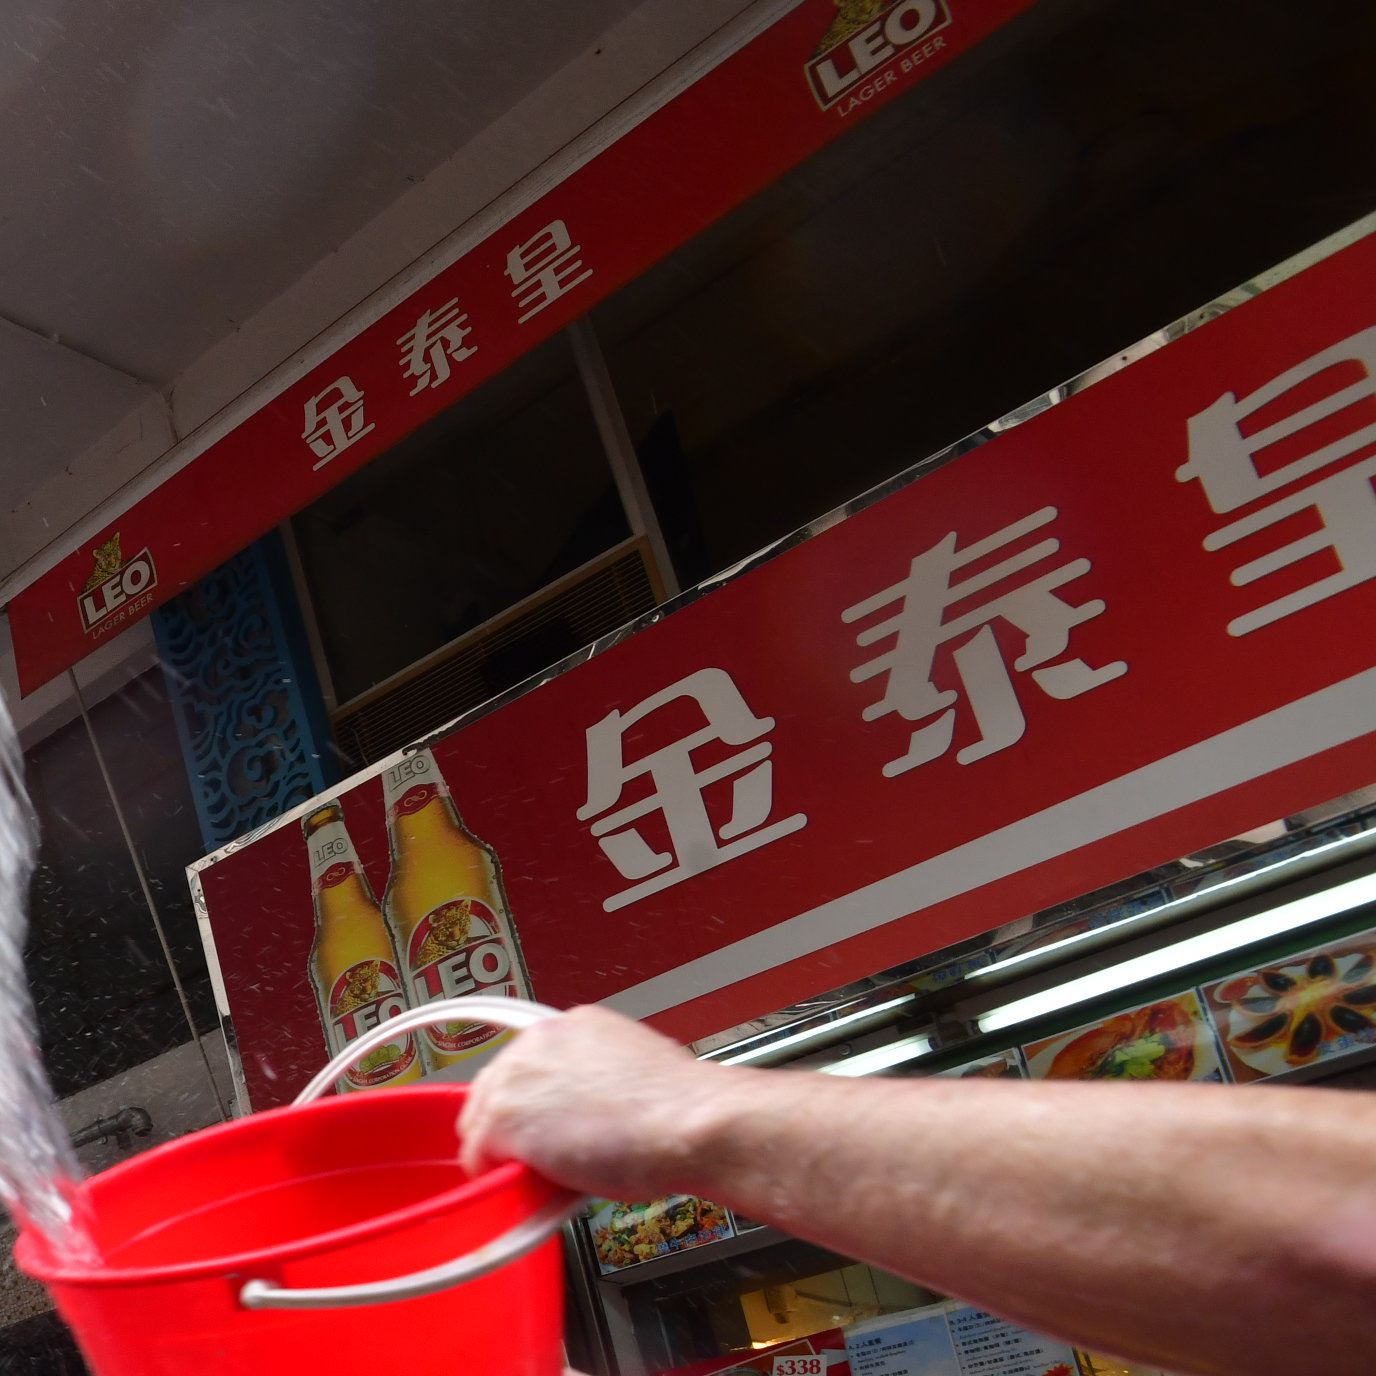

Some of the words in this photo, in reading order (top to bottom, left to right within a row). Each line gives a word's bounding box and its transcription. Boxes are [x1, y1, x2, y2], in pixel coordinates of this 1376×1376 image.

[816, 0, 936, 97] LEO
[837, 71, 897, 117] LAGER
[901, 37, 947, 72] BEER
[301, 218, 593, 471] 金泰皇
[83, 560, 151, 625] LEO
[92, 612, 126, 640] LAGER
[129, 593, 154, 616] BEER
[576, 325, 1376, 914] 金泰皇
[389, 754, 430, 790] LEO
[314, 838, 348, 866] LEO
[414, 943, 511, 1003] LEO
[776, 1358, 821, 1376] $338
